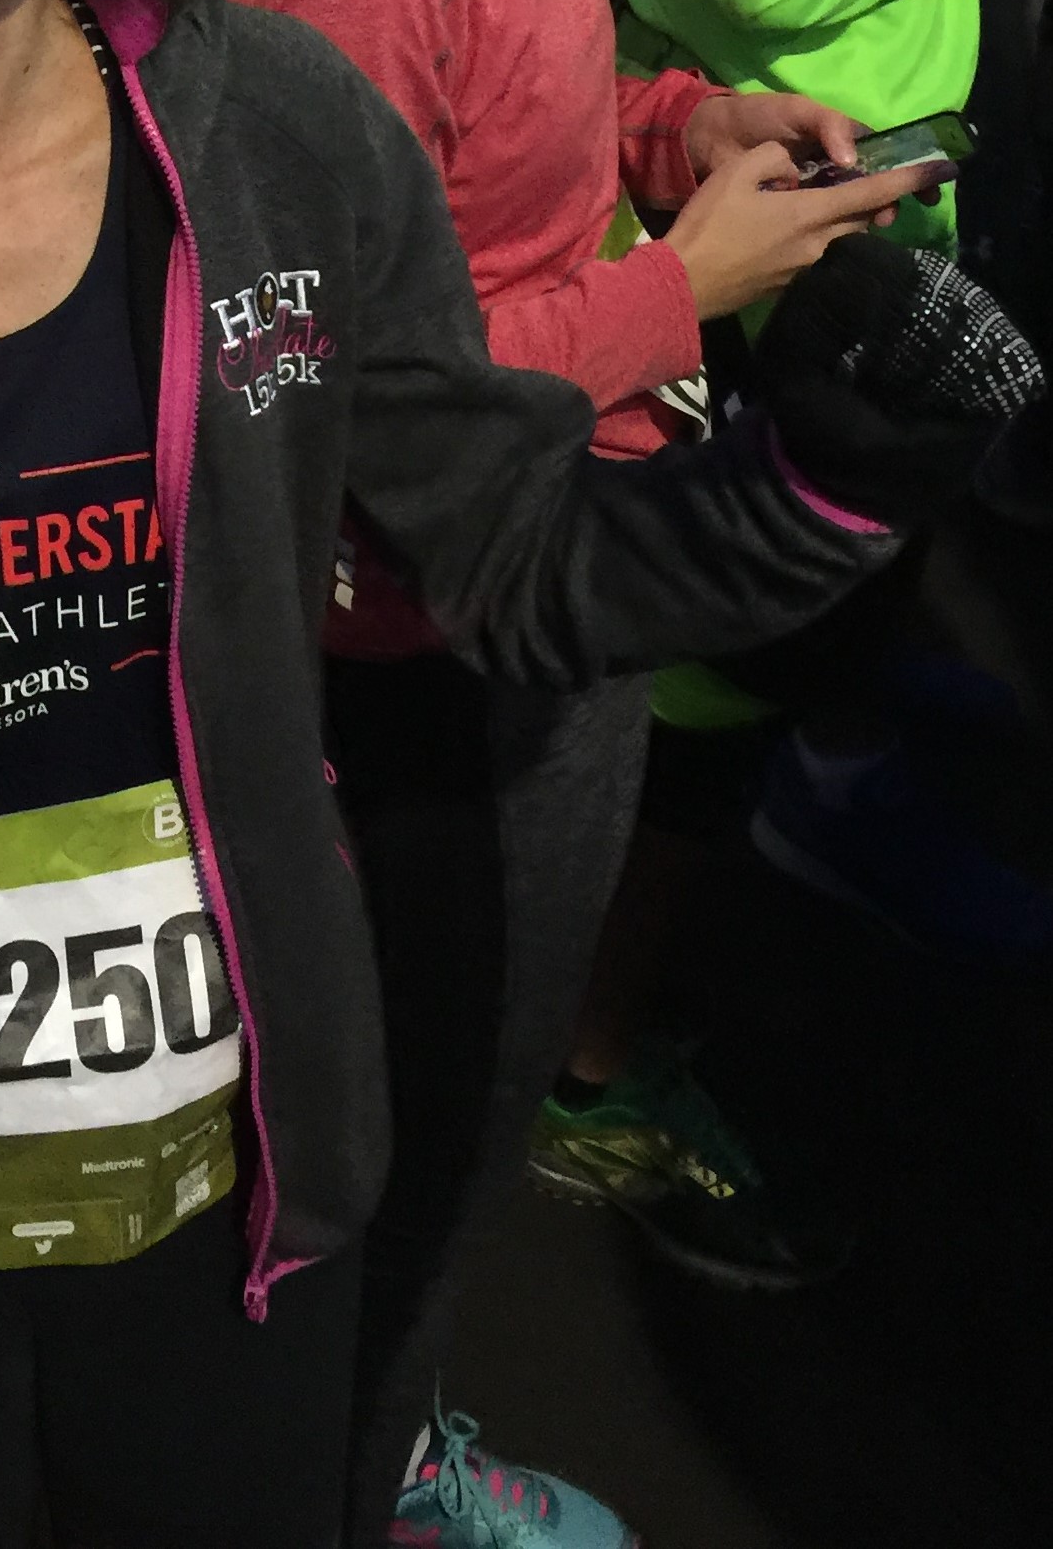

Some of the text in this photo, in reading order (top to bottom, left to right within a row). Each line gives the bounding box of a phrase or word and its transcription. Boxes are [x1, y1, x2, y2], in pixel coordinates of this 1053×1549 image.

[210, 269, 321, 350] HOT
[217, 307, 338, 392] Chlate
[154, 802, 184, 839] B
[81, 1157, 146, 1175] Medtronic
